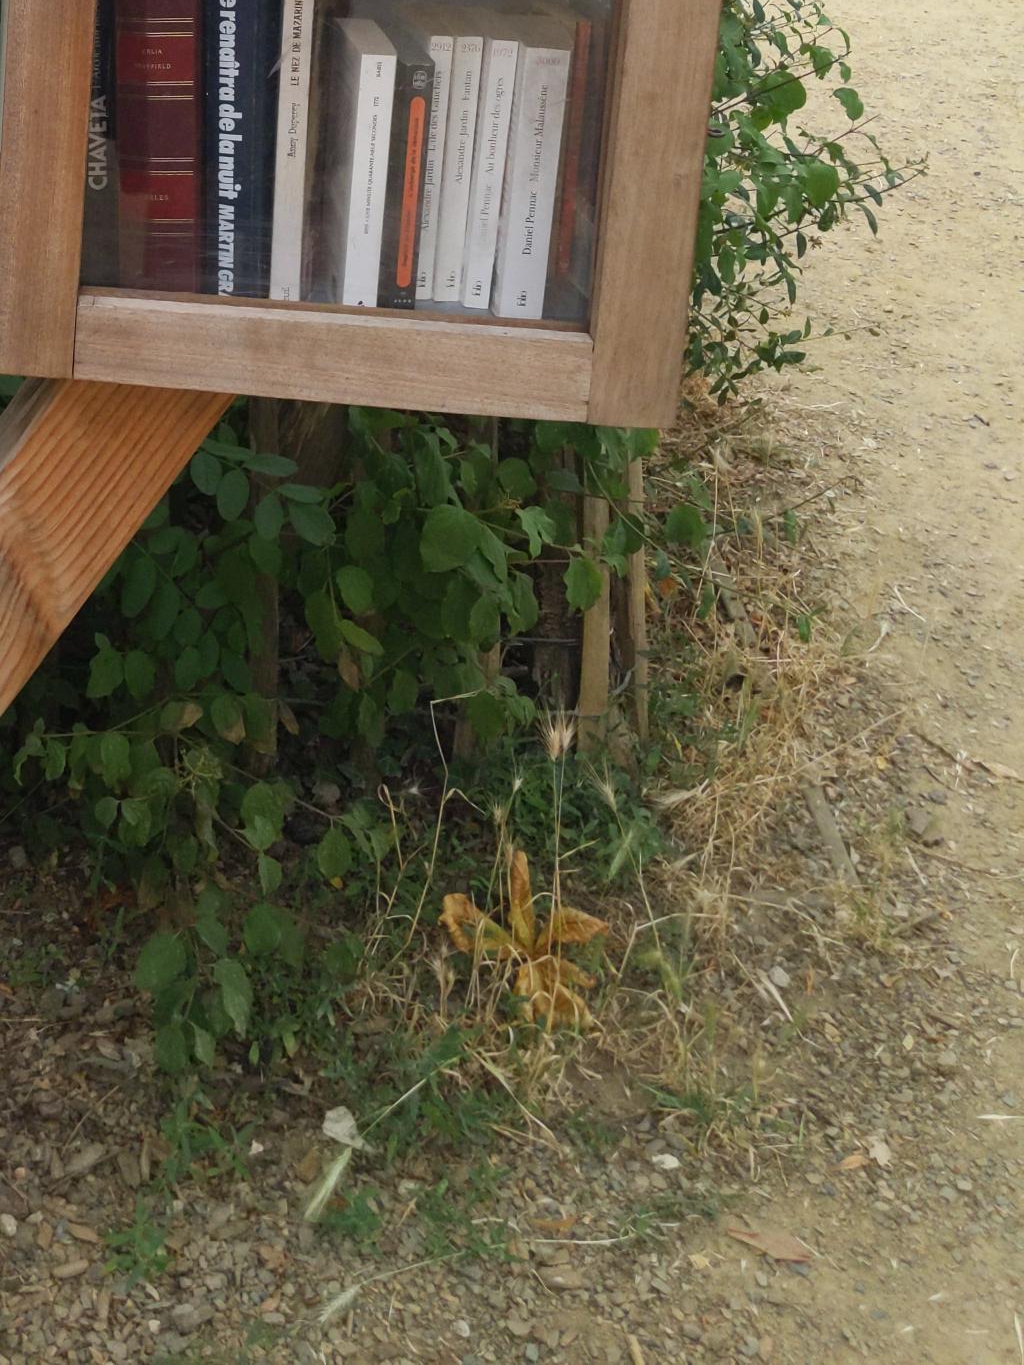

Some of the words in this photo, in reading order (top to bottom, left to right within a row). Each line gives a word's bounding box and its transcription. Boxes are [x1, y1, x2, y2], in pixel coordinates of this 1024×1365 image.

[291, 0, 304, 40] MAZARIN
[218, 9, 240, 101] renaîtra
[291, 41, 302, 53] DE
[431, 41, 452, 52] 2912
[290, 56, 302, 73] NEZ
[290, 75, 301, 86] LE
[493, 76, 506, 103] ogres
[218, 103, 243, 133] de
[456, 109, 470, 137] Jardin
[489, 104, 502, 119] des
[531, 83, 549, 137] Malaussène
[218, 133, 243, 157] la
[485, 120, 500, 160] bonheur
[453, 139, 468, 184] Alexandre
[484, 160, 496, 175] Au
[528, 139, 544, 182] Monsieur
[218, 156, 242, 200] nuit
[524, 190, 538, 224] Pennac
[217, 203, 235, 267] MARTIN
[520, 225, 536, 256] Daniel
